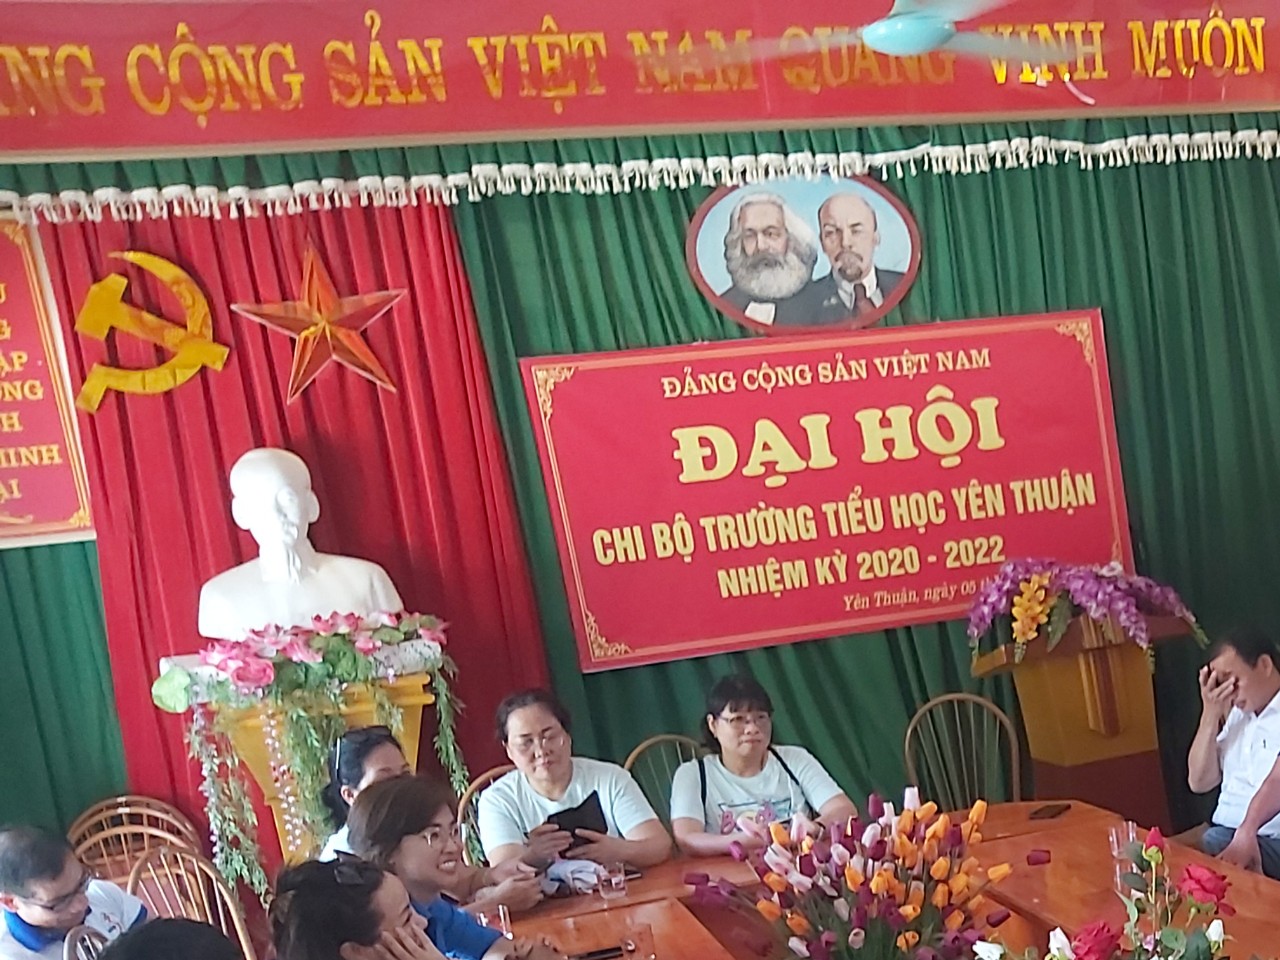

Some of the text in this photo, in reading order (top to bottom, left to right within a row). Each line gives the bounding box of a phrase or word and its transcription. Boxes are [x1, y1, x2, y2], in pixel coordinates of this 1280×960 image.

[0, 44, 105, 116] NG
[126, 22, 304, 129] CỘNG
[324, 9, 448, 107] SẢN
[468, 16, 608, 114] VIỆT
[627, 29, 758, 93] NAM
[779, 26, 957, 95] QUANG
[979, 23, 1108, 84] VINH
[0, 379, 44, 401] NG
[661, 348, 991, 399] ĐẢNG CỘNG SẢN VIỆT NAM
[0, 411, 23, 433] H
[672, 384, 1005, 488] ĐẠI HỘI
[592, 468, 1096, 566] CHI BỘ TRƯỜNG TIỂU HỌC YÊN THUẬN
[717, 557, 809, 598] NHIỆM
[815, 549, 848, 585] KỲ
[856, 545, 920, 581] 2020
[944, 535, 1005, 569] 2022
[844, 595, 869, 612] Yên
[874, 588, 921, 607] Thuận,
[924, 580, 957, 603] ngày
[961, 580, 976, 595] 05
